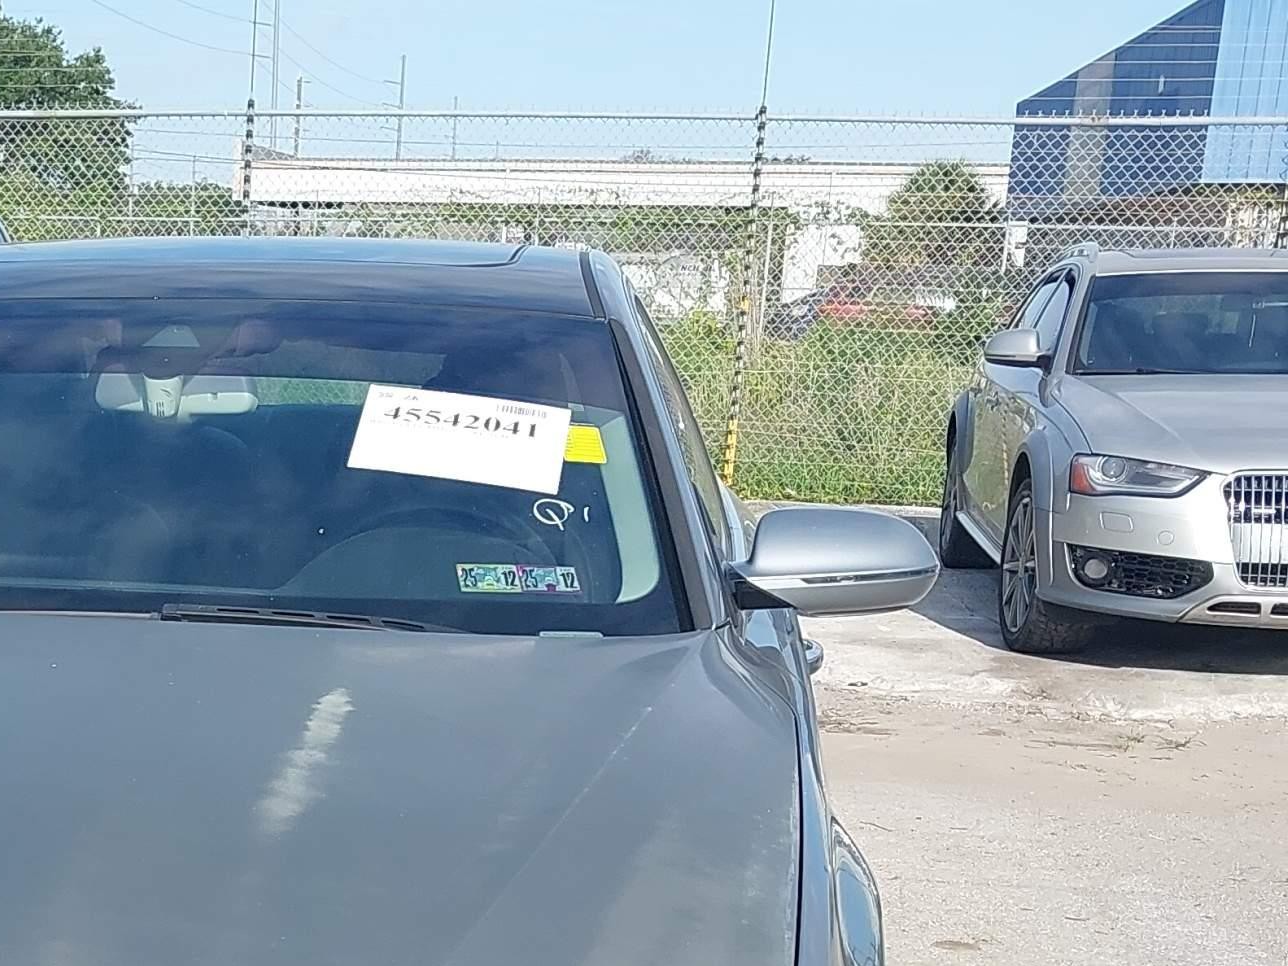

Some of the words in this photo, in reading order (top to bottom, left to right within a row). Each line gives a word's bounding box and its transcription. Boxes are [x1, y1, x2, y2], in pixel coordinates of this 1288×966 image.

[384, 405, 537, 438] 45542041
[460, 567, 478, 588] 25
[501, 570, 519, 588] 12
[522, 568, 539, 588] 25
[560, 571, 578, 589] 12
